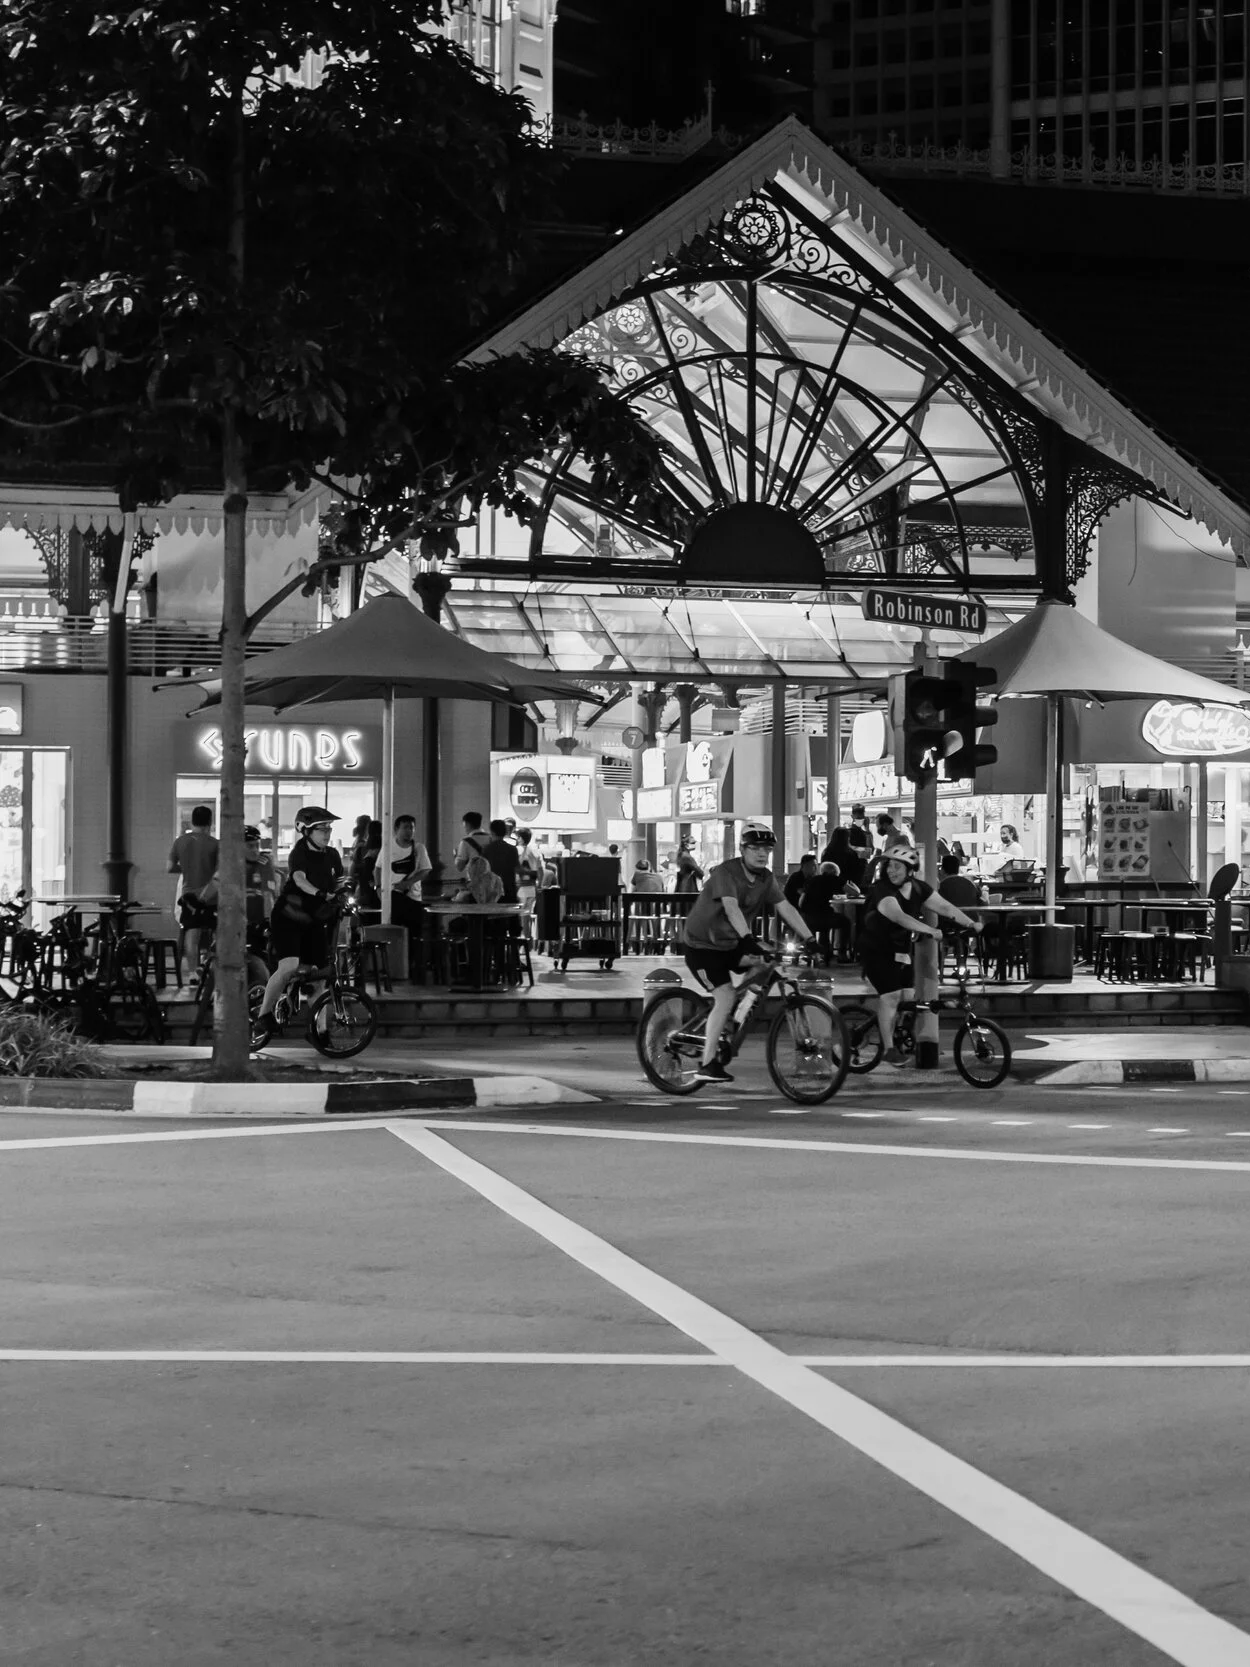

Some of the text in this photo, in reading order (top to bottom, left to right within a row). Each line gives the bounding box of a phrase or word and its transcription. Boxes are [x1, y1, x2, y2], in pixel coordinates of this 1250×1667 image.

[874, 593, 979, 628] Robinson Rd
[630, 735, 637, 745] 7
